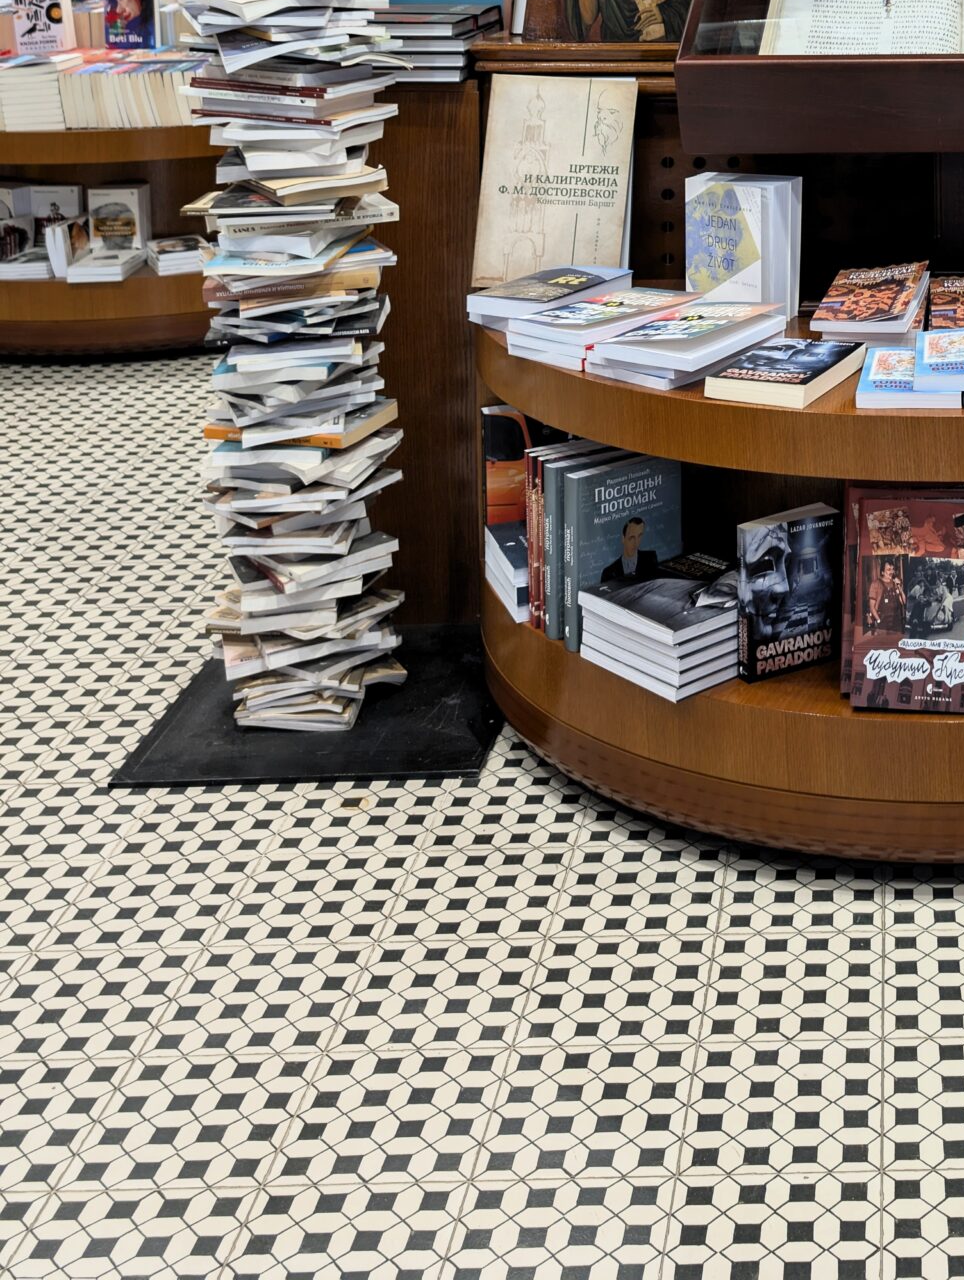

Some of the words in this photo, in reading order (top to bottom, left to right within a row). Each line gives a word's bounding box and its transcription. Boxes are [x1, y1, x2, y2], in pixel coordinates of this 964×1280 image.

[109, 35, 128, 43] Beti
[129, 35, 143, 43] Blu
[569, 164, 619, 175] ЦРТЕЖИ
[524, 174, 533, 183] И
[536, 175, 618, 188] КАЛИГРАФИЈА
[498, 185, 510, 194] Ф.
[513, 186, 527, 195] М.
[530, 187, 618, 199] ДОСТОЈЕВСКОГ
[537, 198, 586, 206] Константин
[588, 199, 615, 209] Баршт
[705, 215, 737, 231] JEDAN
[707, 235, 737, 251] DRUGI
[707, 252, 735, 271] ŽIVOT
[595, 475, 662, 502] Последњи
[601, 490, 656, 514] потомак
[756, 628, 832, 660] GAVRANOV
[756, 644, 832, 675] PARADOKS
